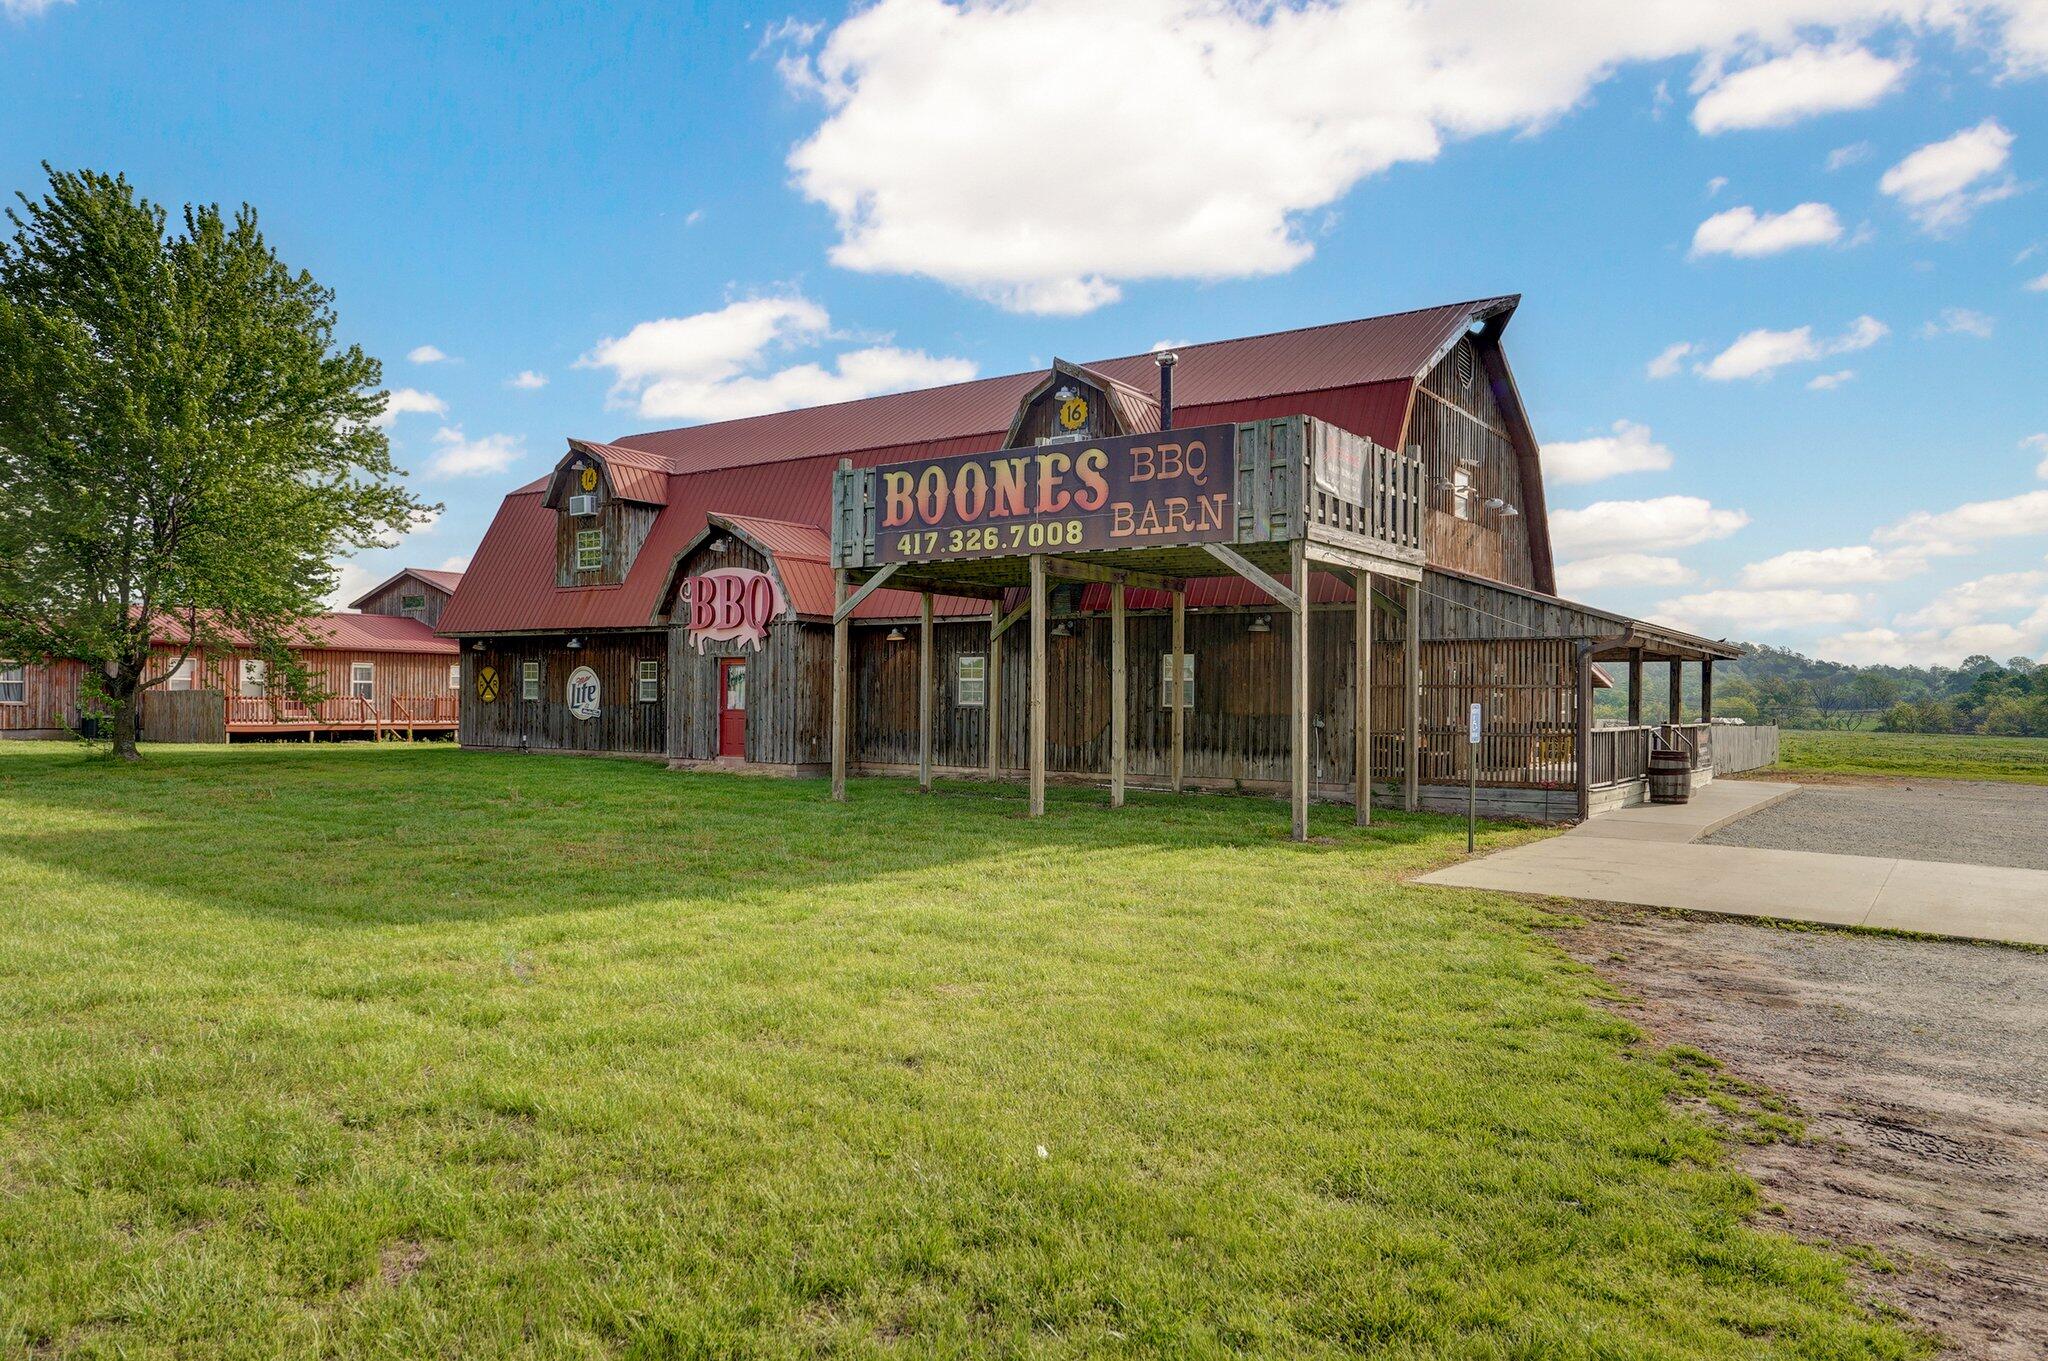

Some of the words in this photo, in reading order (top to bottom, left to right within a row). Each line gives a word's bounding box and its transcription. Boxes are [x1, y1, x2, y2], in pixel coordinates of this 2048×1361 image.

[1067, 404, 1081, 422] 16
[1129, 440, 1208, 486] BBQ
[882, 448, 1109, 527] BOONES
[897, 520, 1083, 556] 417.326.7008
[1109, 493, 1228, 538] BARN
[684, 575, 773, 638] BBQ
[571, 683, 597, 709] Lite
